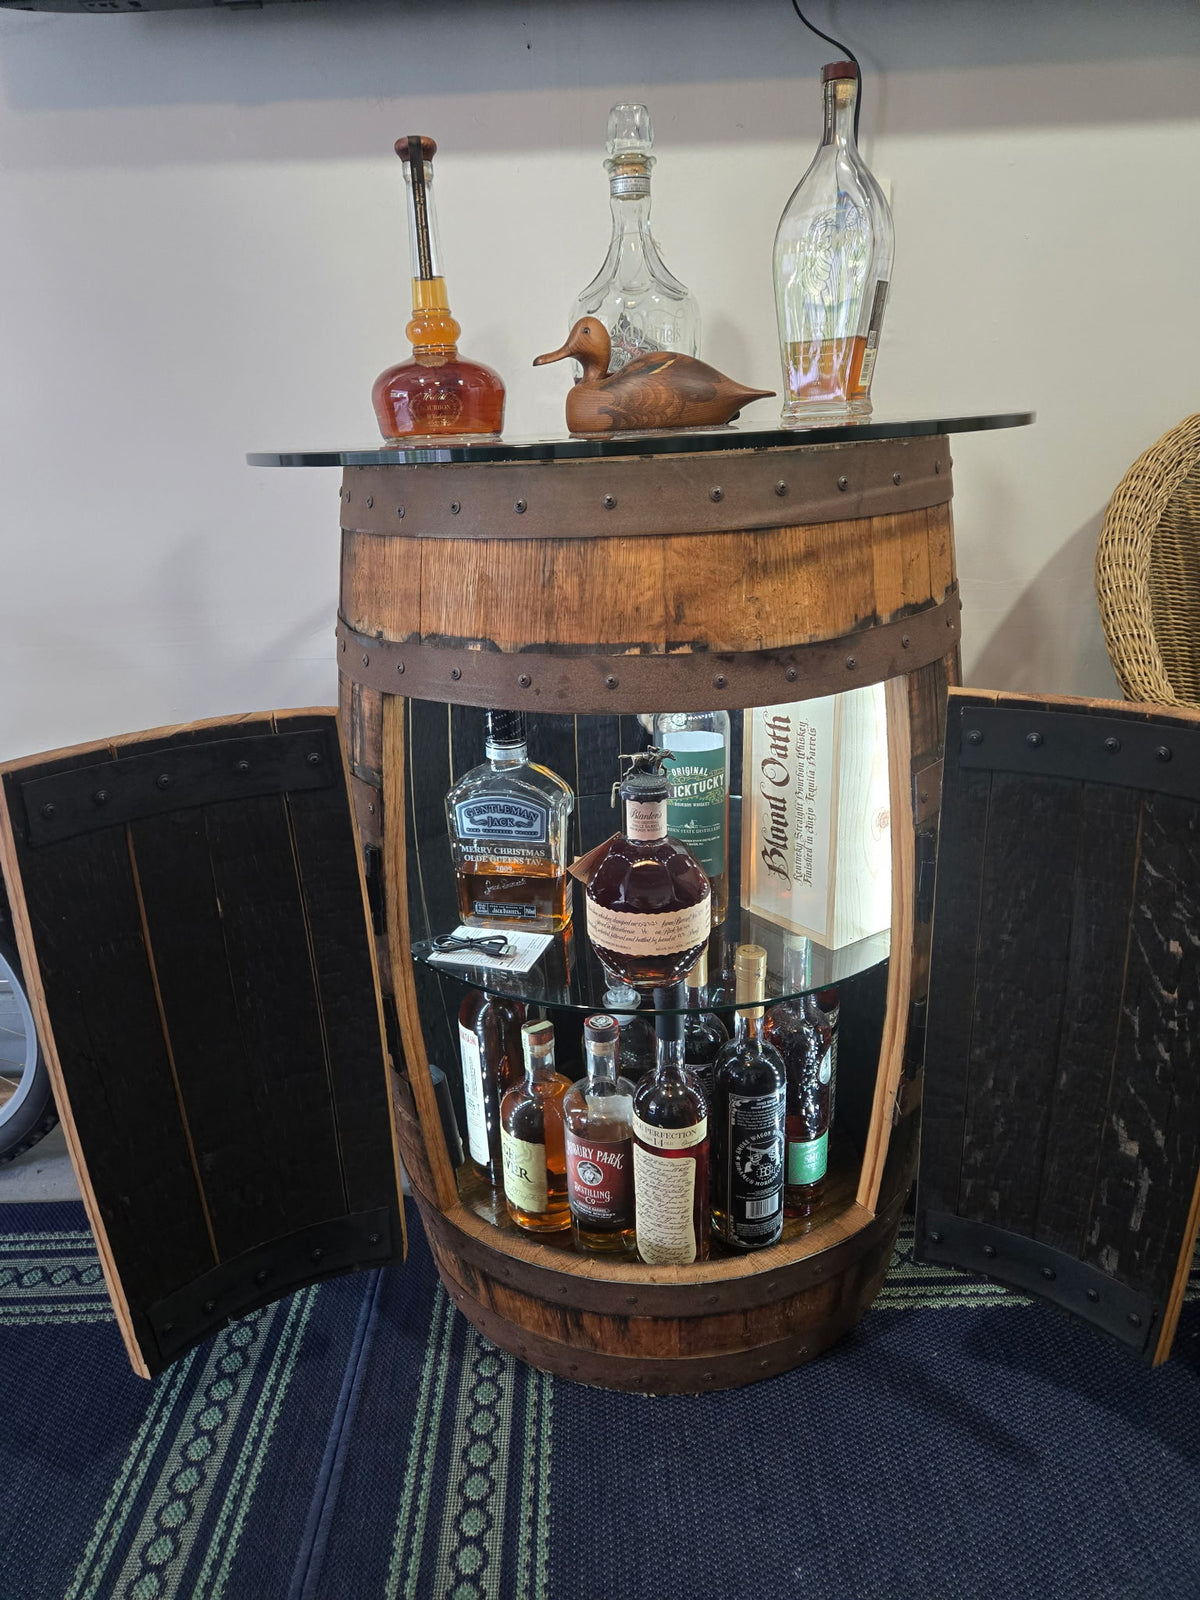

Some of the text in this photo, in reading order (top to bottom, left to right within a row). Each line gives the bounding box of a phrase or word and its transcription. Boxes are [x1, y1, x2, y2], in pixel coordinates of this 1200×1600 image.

[807, 727, 817, 767] Barrels
[671, 766, 709, 777] ORIGINAL
[673, 773, 725, 799] ICKTUCKY
[805, 770, 817, 801] Tequila
[760, 709, 792, 891] Blood Oath
[793, 721, 808, 886] Kentucky Straight Bourbon Whiskey
[464, 804, 539, 822] GENTLEMAN
[487, 816, 515, 827] JACK
[461, 845, 545, 856] MERRY CHRISTMAS
[806, 836, 813, 845] in
[464, 854, 543, 866] OLDE QUEENS TAV.
[803, 848, 813, 887] Finished
[644, 1126, 698, 1140] PERFECTION
[596, 1150, 625, 1170] PARK
[573, 1180, 611, 1203] DISTILLING
